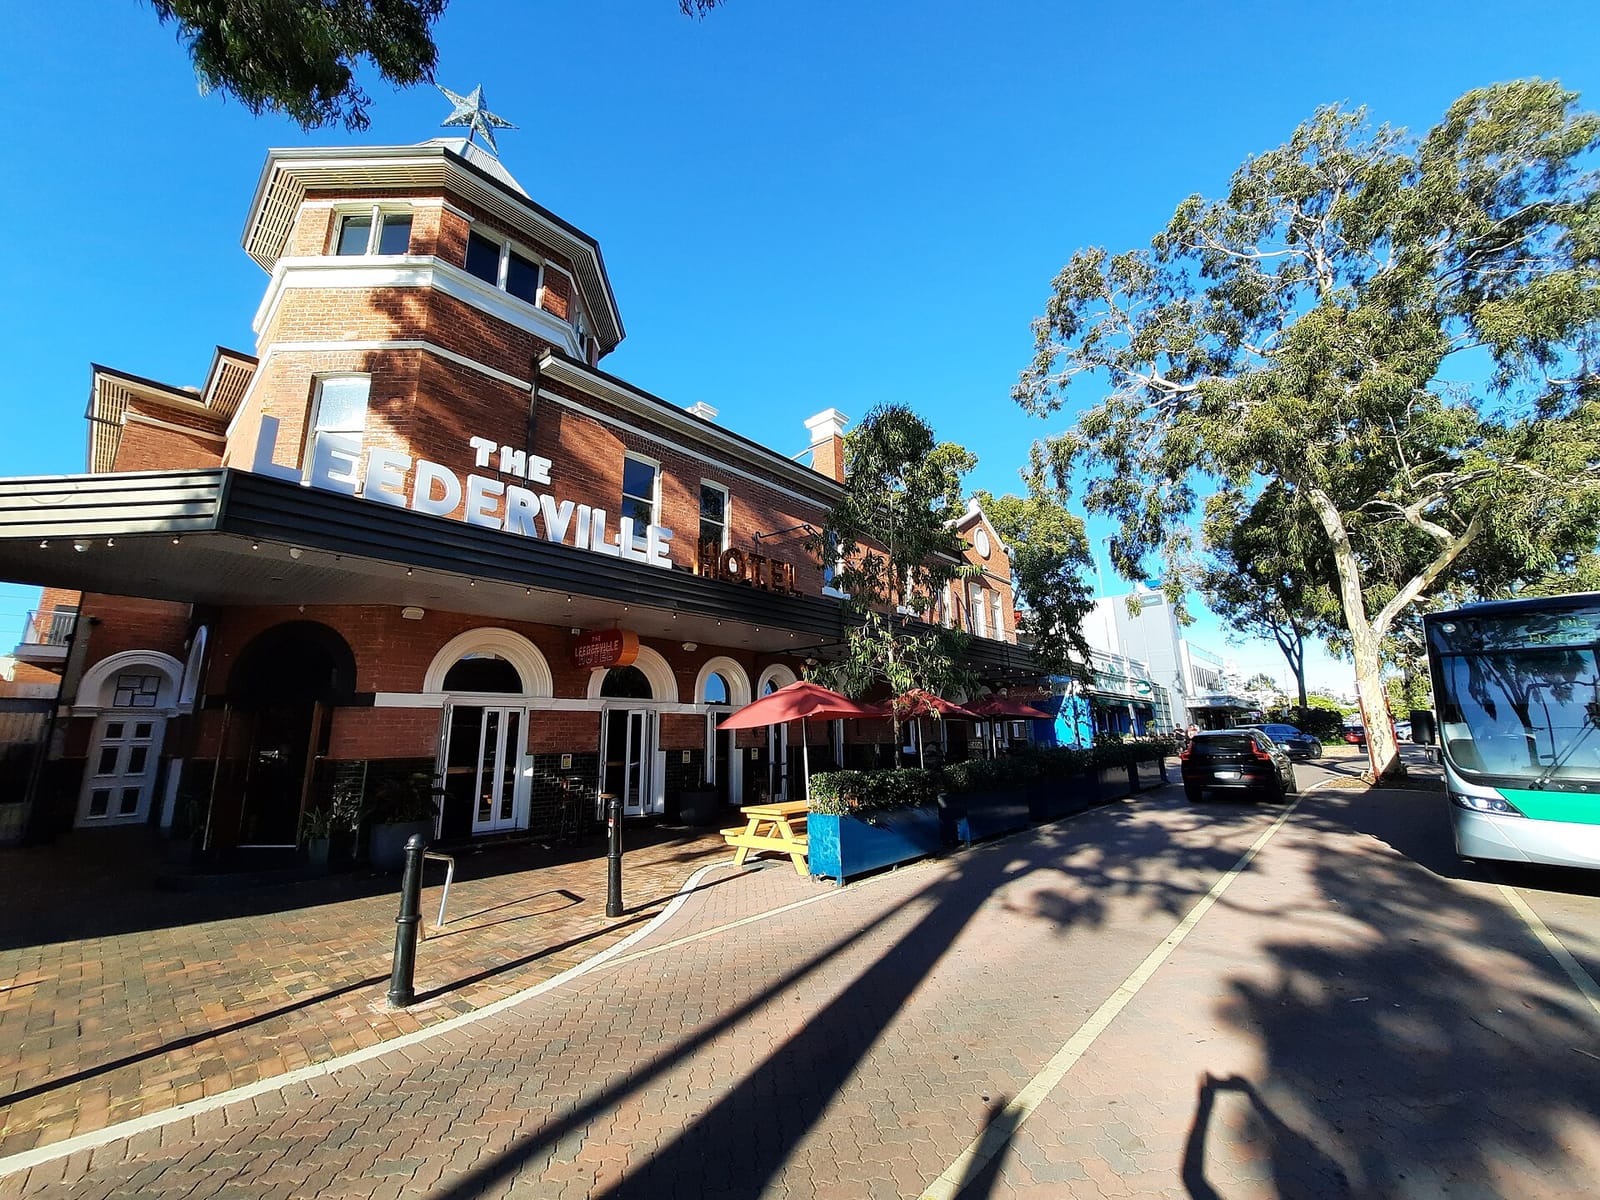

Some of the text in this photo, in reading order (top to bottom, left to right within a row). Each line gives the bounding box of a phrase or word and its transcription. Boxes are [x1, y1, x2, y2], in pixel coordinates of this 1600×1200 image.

[469, 435, 553, 486] THE
[252, 414, 673, 569] LEEDERVILLE
[692, 537, 803, 597] HOTEL
